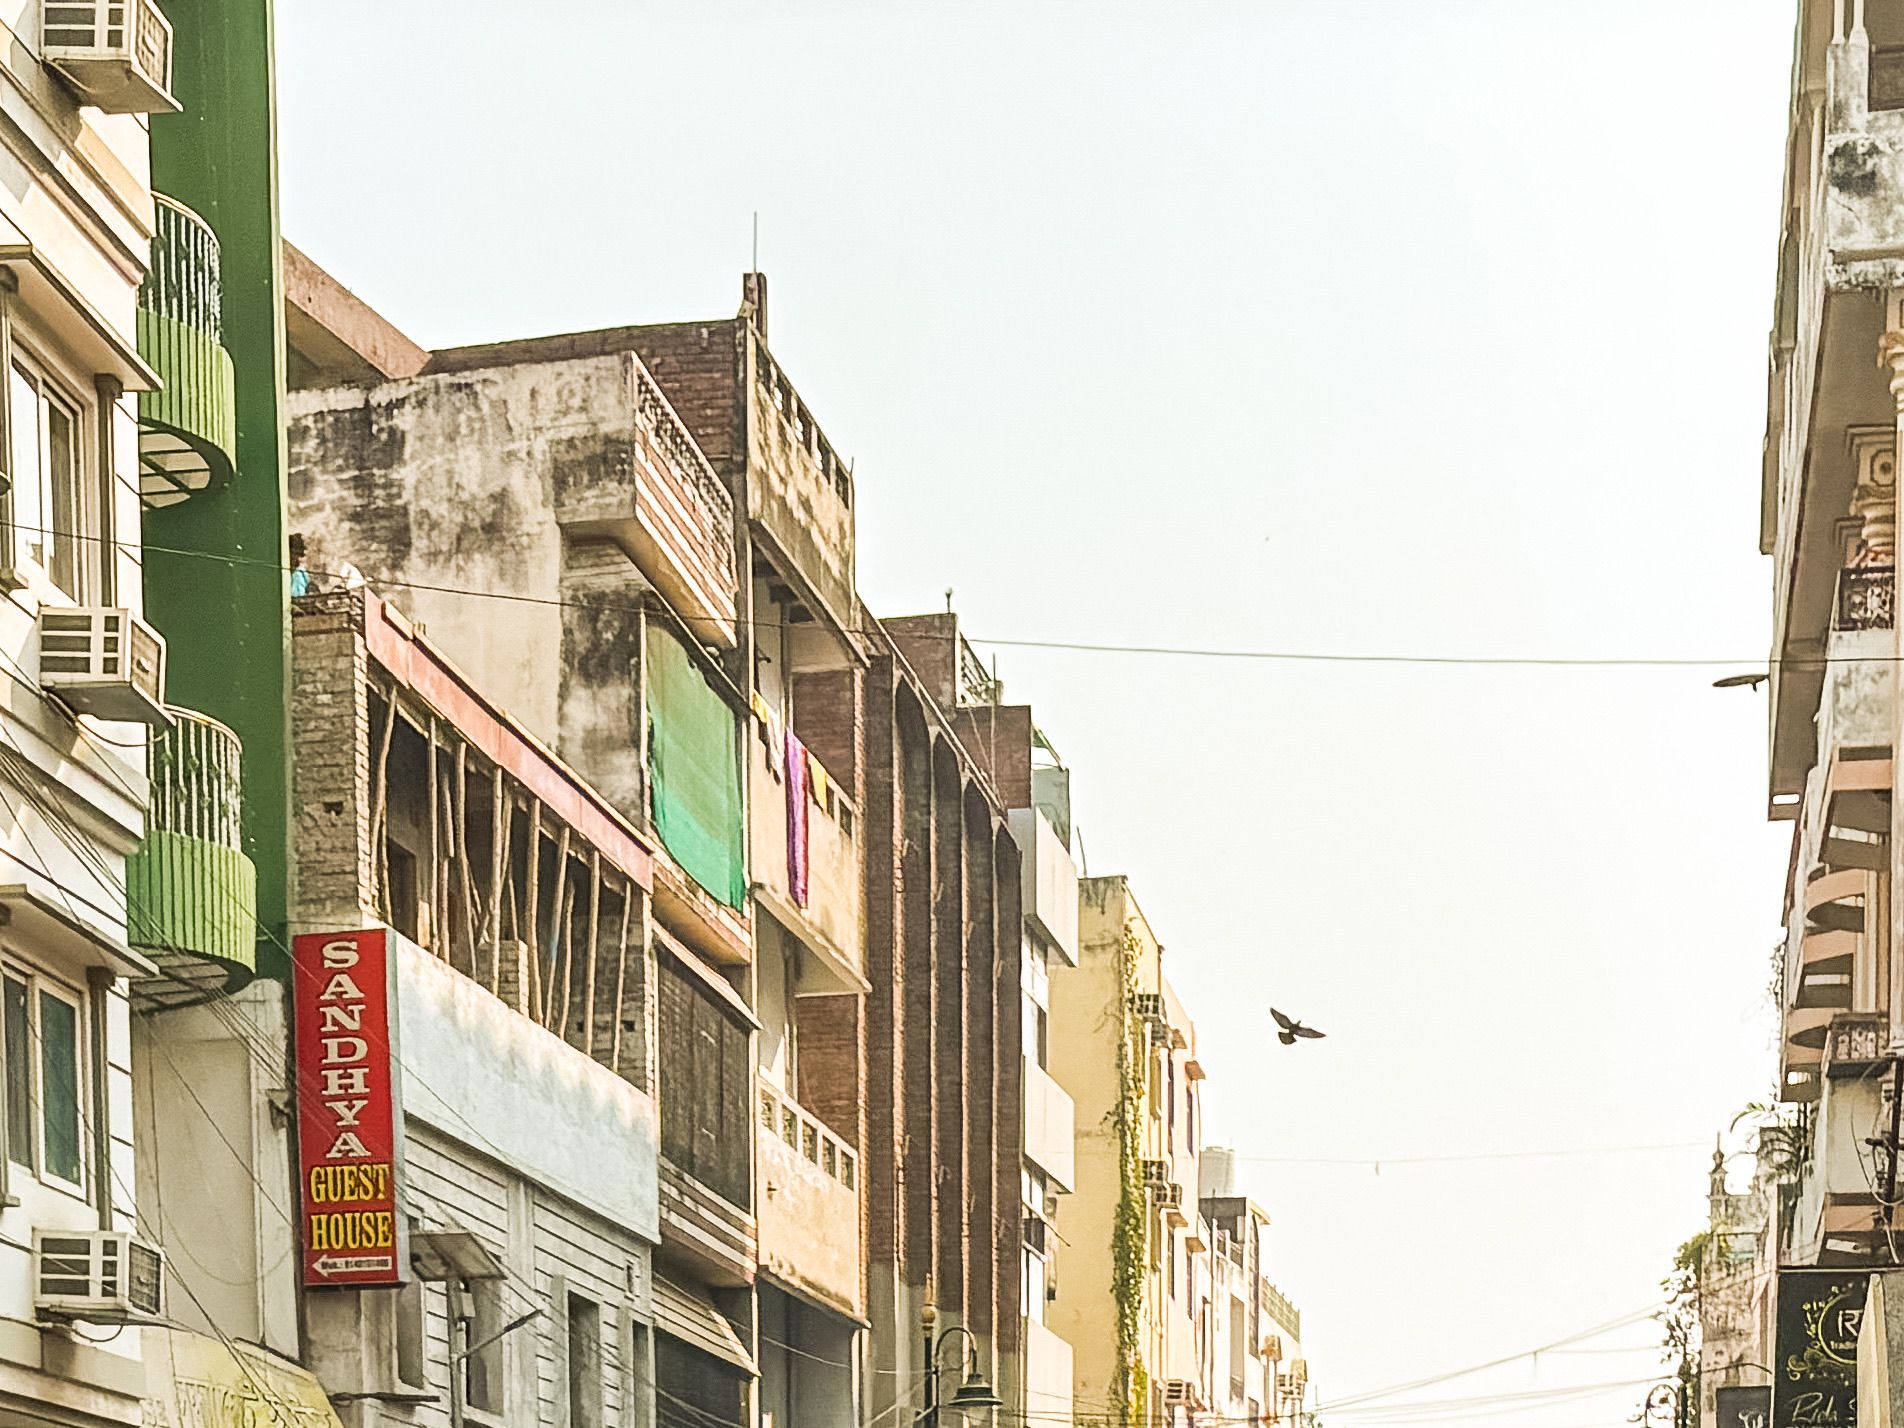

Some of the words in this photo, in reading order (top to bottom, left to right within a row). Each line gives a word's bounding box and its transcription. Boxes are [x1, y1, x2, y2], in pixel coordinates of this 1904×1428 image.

[319, 940, 372, 1159] SANDHYA
[309, 1163, 390, 1203] GUEST
[309, 1211, 393, 1250] HOUSE
